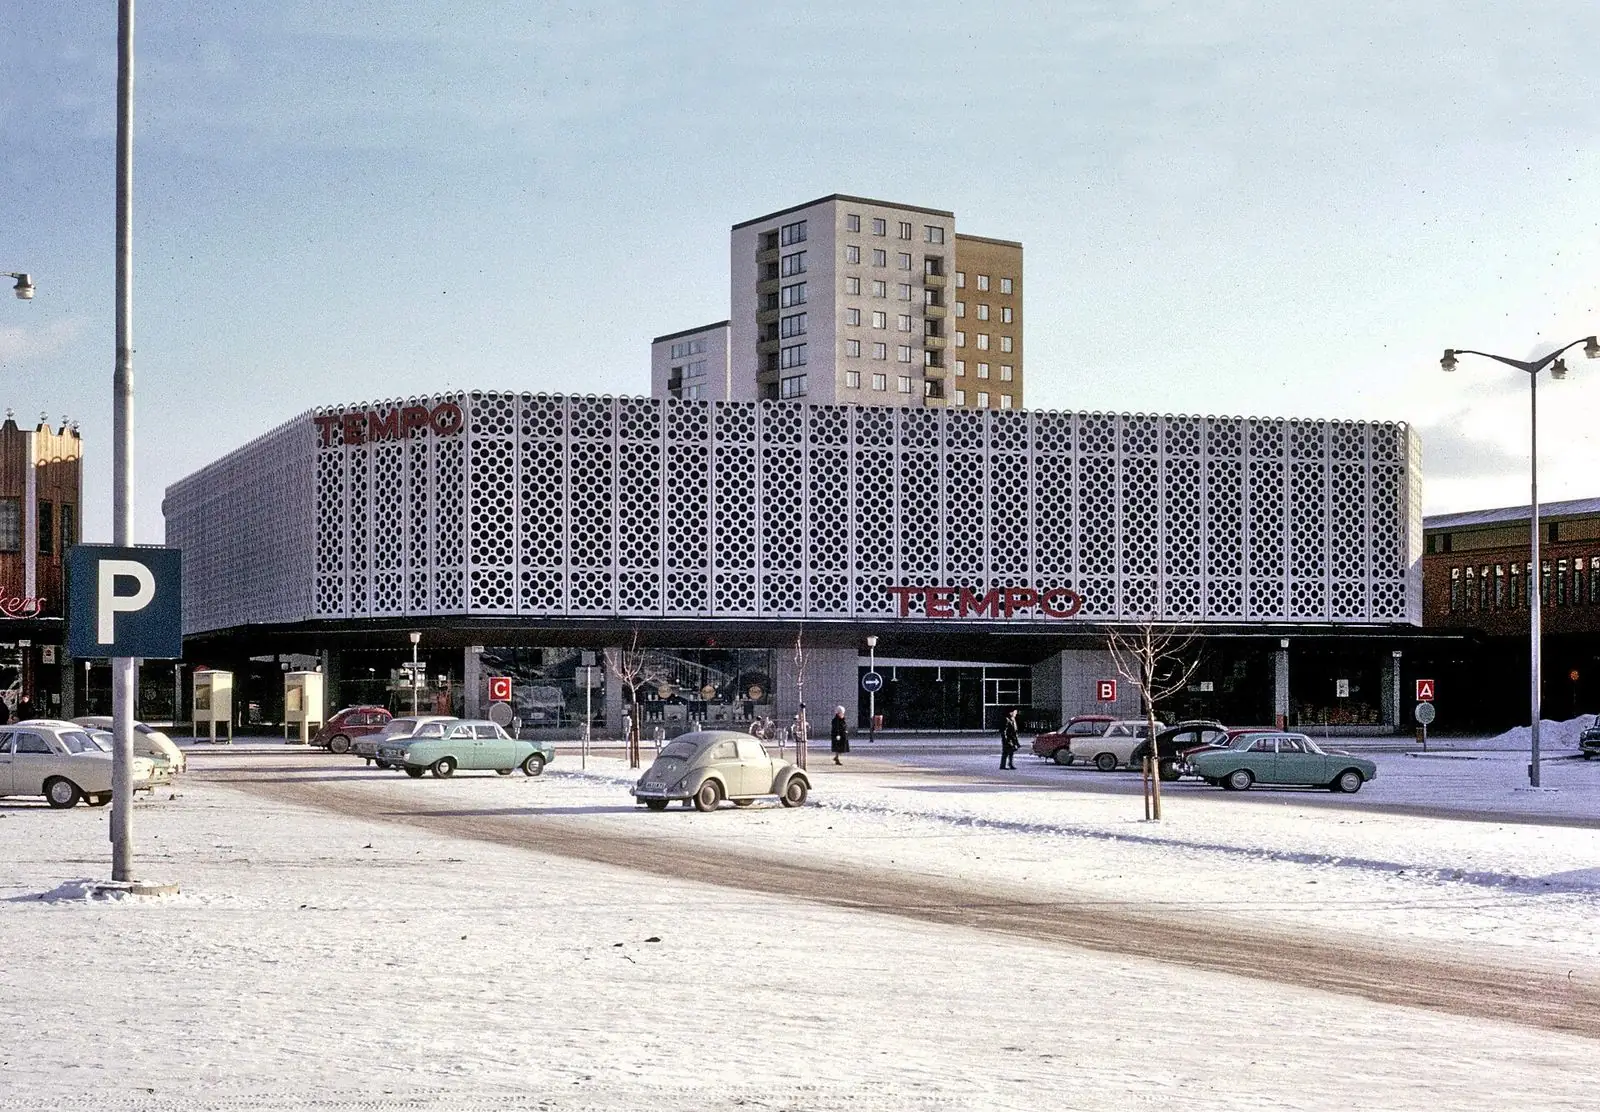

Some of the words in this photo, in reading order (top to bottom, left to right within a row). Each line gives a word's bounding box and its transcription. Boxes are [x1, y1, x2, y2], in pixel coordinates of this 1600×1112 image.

[313, 402, 464, 447] TEMPO
[98, 560, 156, 645] P
[887, 586, 1083, 618] TEMPO
[494, 682, 507, 697] C
[1101, 683, 1112, 698] B
[1419, 684, 1433, 698] A
